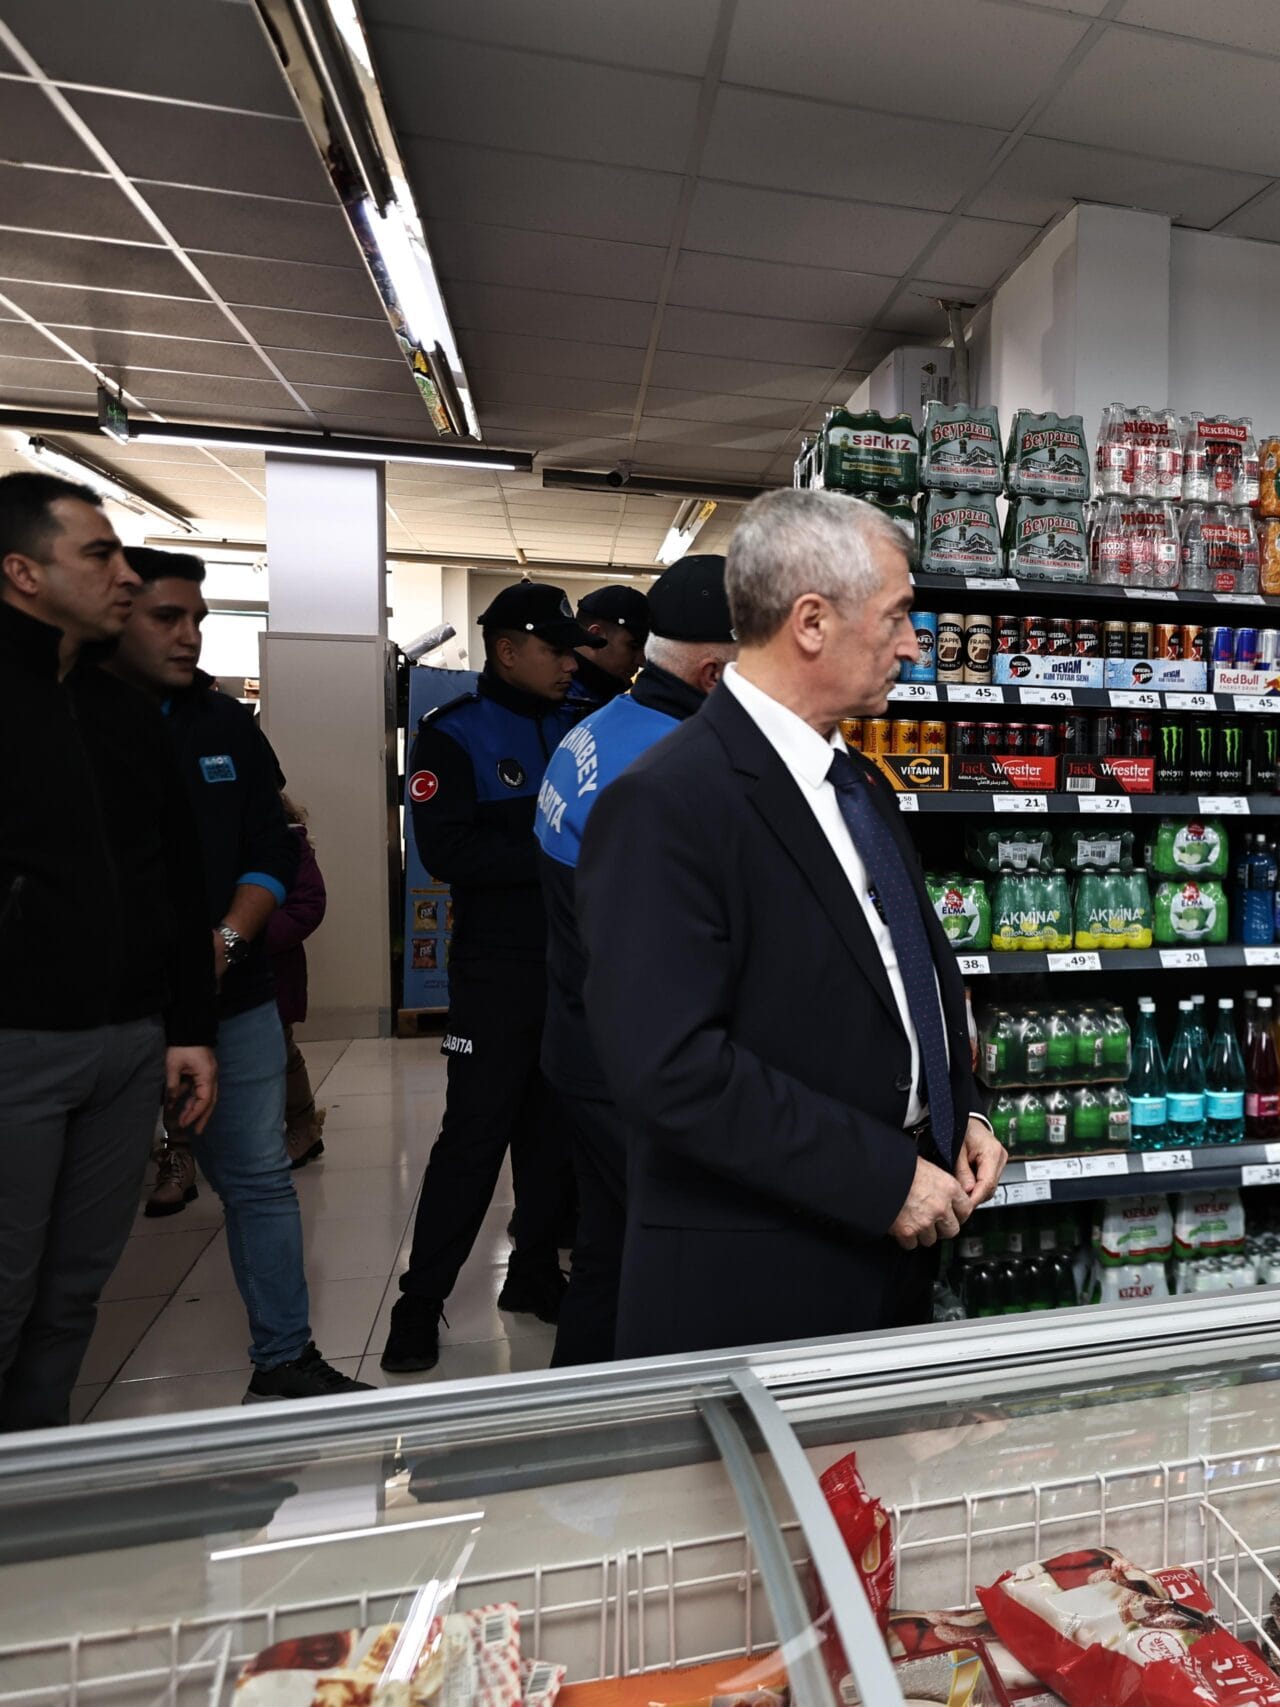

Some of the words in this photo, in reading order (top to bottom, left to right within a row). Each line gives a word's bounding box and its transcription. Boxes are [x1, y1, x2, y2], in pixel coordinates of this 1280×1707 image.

[1124, 420, 1168, 435] NİĞDE
[1200, 424, 1245, 438] ŞEKERSİZ
[1051, 659, 1082, 674] DEVAM
[1220, 673, 1239, 684] Red
[1240, 674, 1259, 685] Bull
[908, 686, 926, 695] 30
[975, 688, 992, 697] 45
[1050, 692, 1066, 701] 49
[1138, 695, 1154, 703] 45
[1191, 696, 1206, 705] 49
[1258, 699, 1273, 708] 45
[900, 766, 940, 775] VITAMIN
[959, 762, 986, 775] Jack
[1068, 762, 1095, 776] Jack
[1024, 798, 1040, 808] 21
[1105, 799, 1120, 808] 27
[942, 906, 966, 914] ELMA
[1088, 904, 1142, 922] AKMİNA
[1000, 907, 1056, 925] AKMİNA
[1070, 956, 1086, 965] 49
[1186, 952, 1200, 962] 20
[963, 959, 979, 969] 38
[1172, 1154, 1186, 1164] 24
